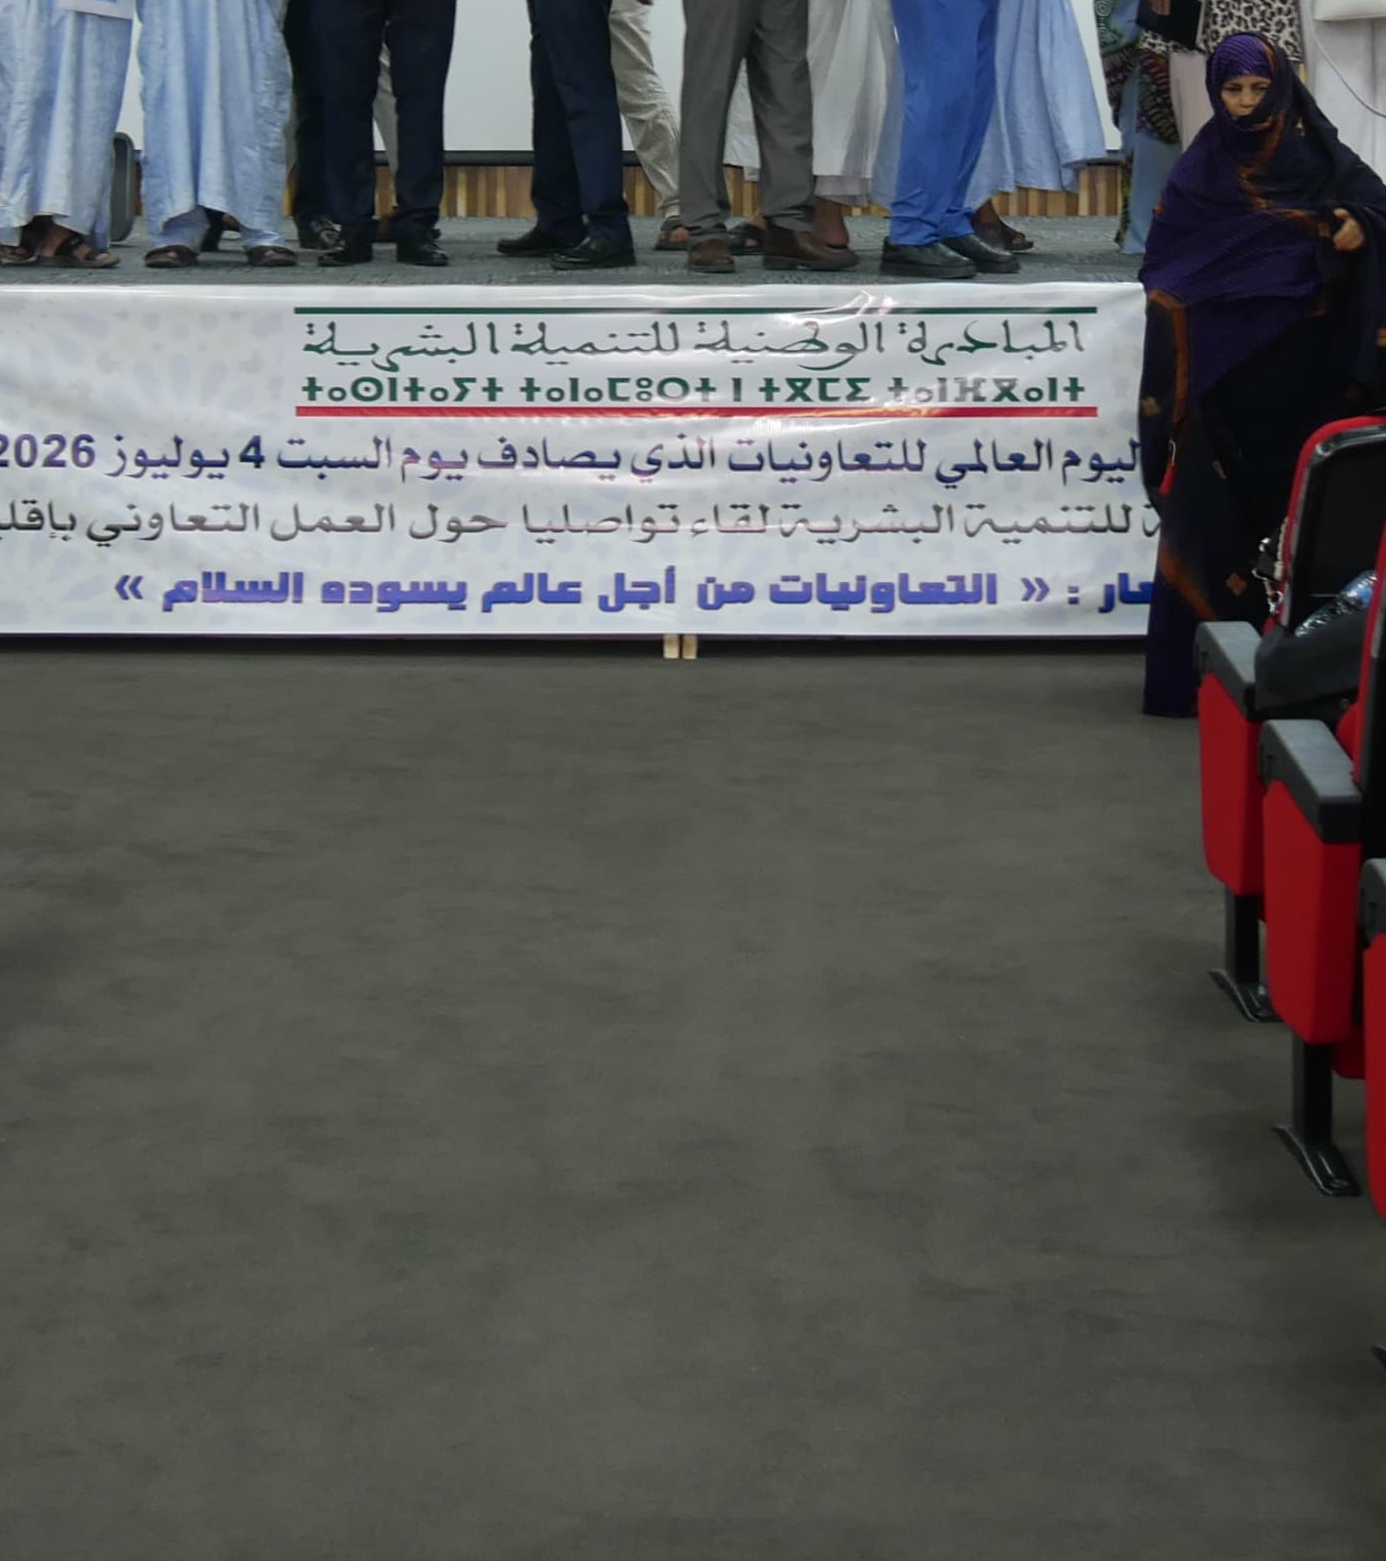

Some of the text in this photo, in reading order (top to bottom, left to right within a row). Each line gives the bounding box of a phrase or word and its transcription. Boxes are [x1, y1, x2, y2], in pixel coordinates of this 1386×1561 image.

[301, 319, 1085, 373] المبادرة الوطنية للتنمية البشرية
[104, 434, 231, 481] يوليوز
[239, 435, 266, 469] 4
[274, 434, 393, 481] السبت
[400, 445, 470, 483] يوم
[477, 435, 623, 480] يصادف
[630, 433, 717, 483] الذي
[726, 437, 927, 484] للتعاونيات
[935, 437, 1053, 489] العالمي
[1060, 437, 1142, 486] ليوم
[84, 501, 261, 549] التعاوني
[269, 502, 396, 543] العمل
[408, 503, 509, 543] حول
[522, 502, 681, 545] تواصليا
[690, 502, 771, 538] لقاء
[779, 503, 955, 546] البشرية
[963, 502, 1133, 545] للتنمية
[161, 570, 306, 613] السلام
[319, 580, 469, 613] يسوده
[480, 571, 584, 614] عالم
[596, 564, 677, 614] أجل
[696, 575, 757, 612] من
[769, 572, 998, 614] التعاونيات
